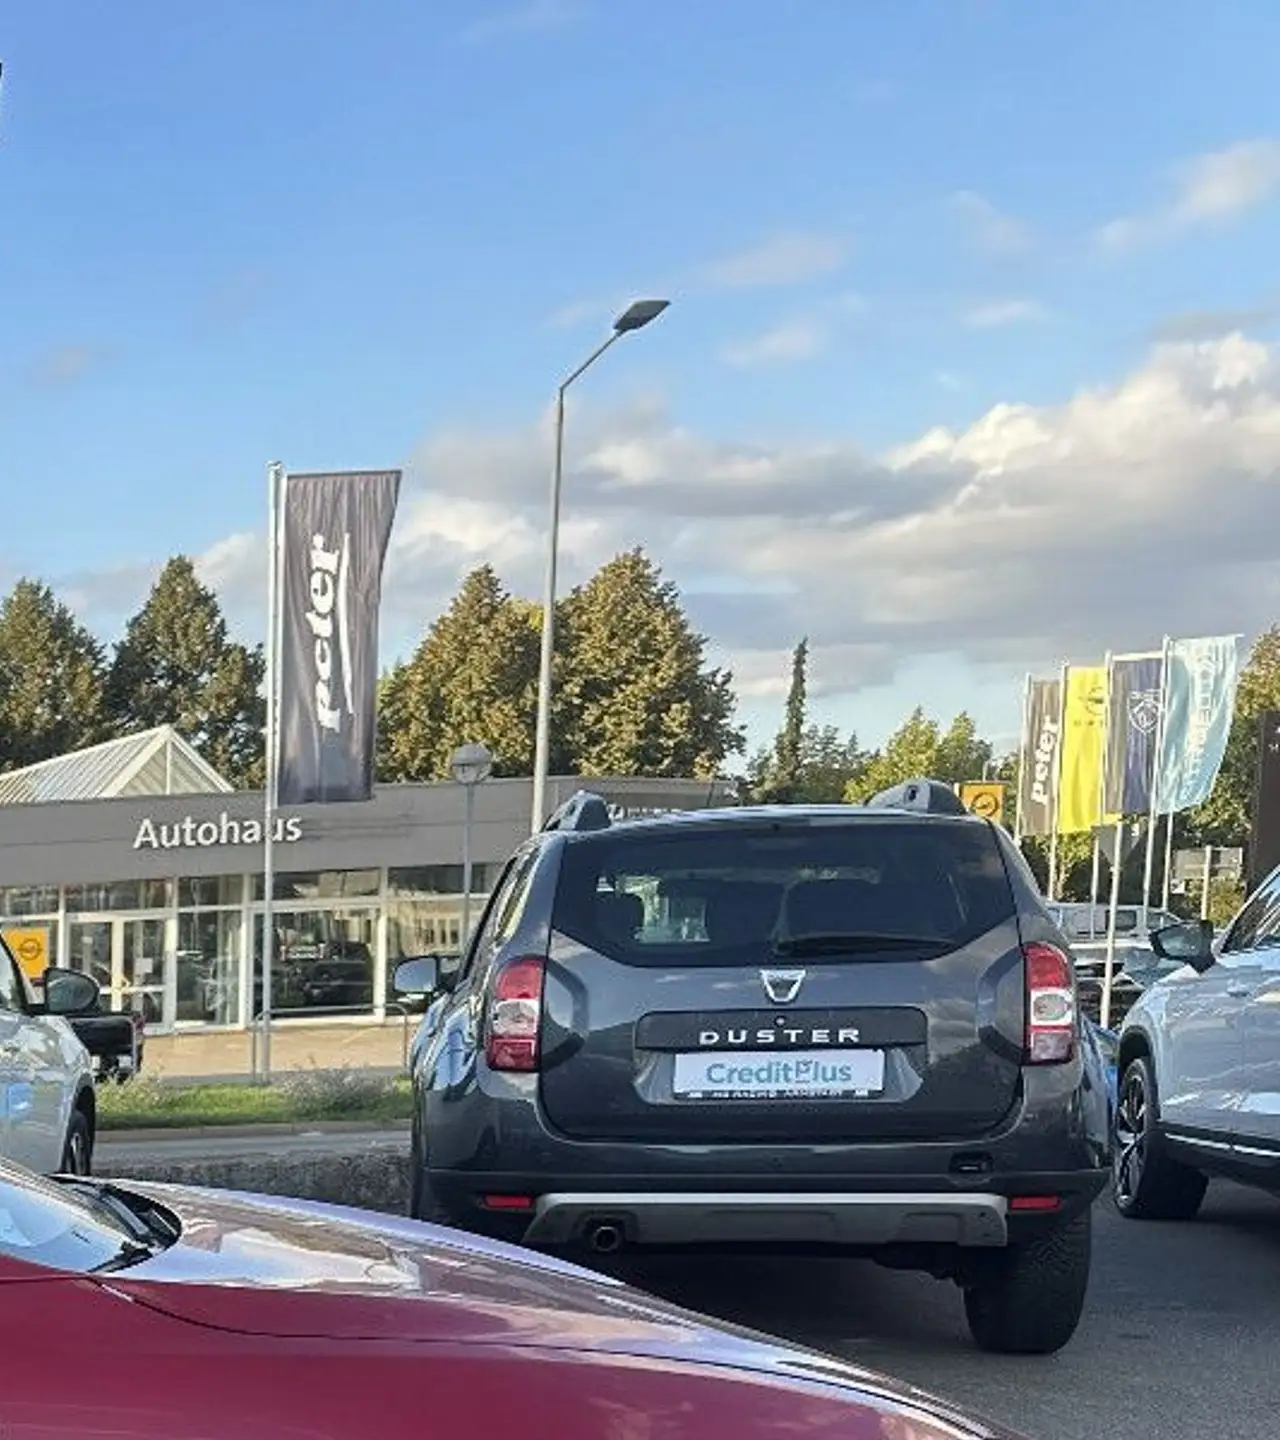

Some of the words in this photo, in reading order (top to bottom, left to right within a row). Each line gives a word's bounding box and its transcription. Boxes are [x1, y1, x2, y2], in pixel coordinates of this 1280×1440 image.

[132, 812, 303, 849] Autohaus
[698, 1029, 860, 1045] DUSTER
[705, 1060, 852, 1084] CreditPlus
